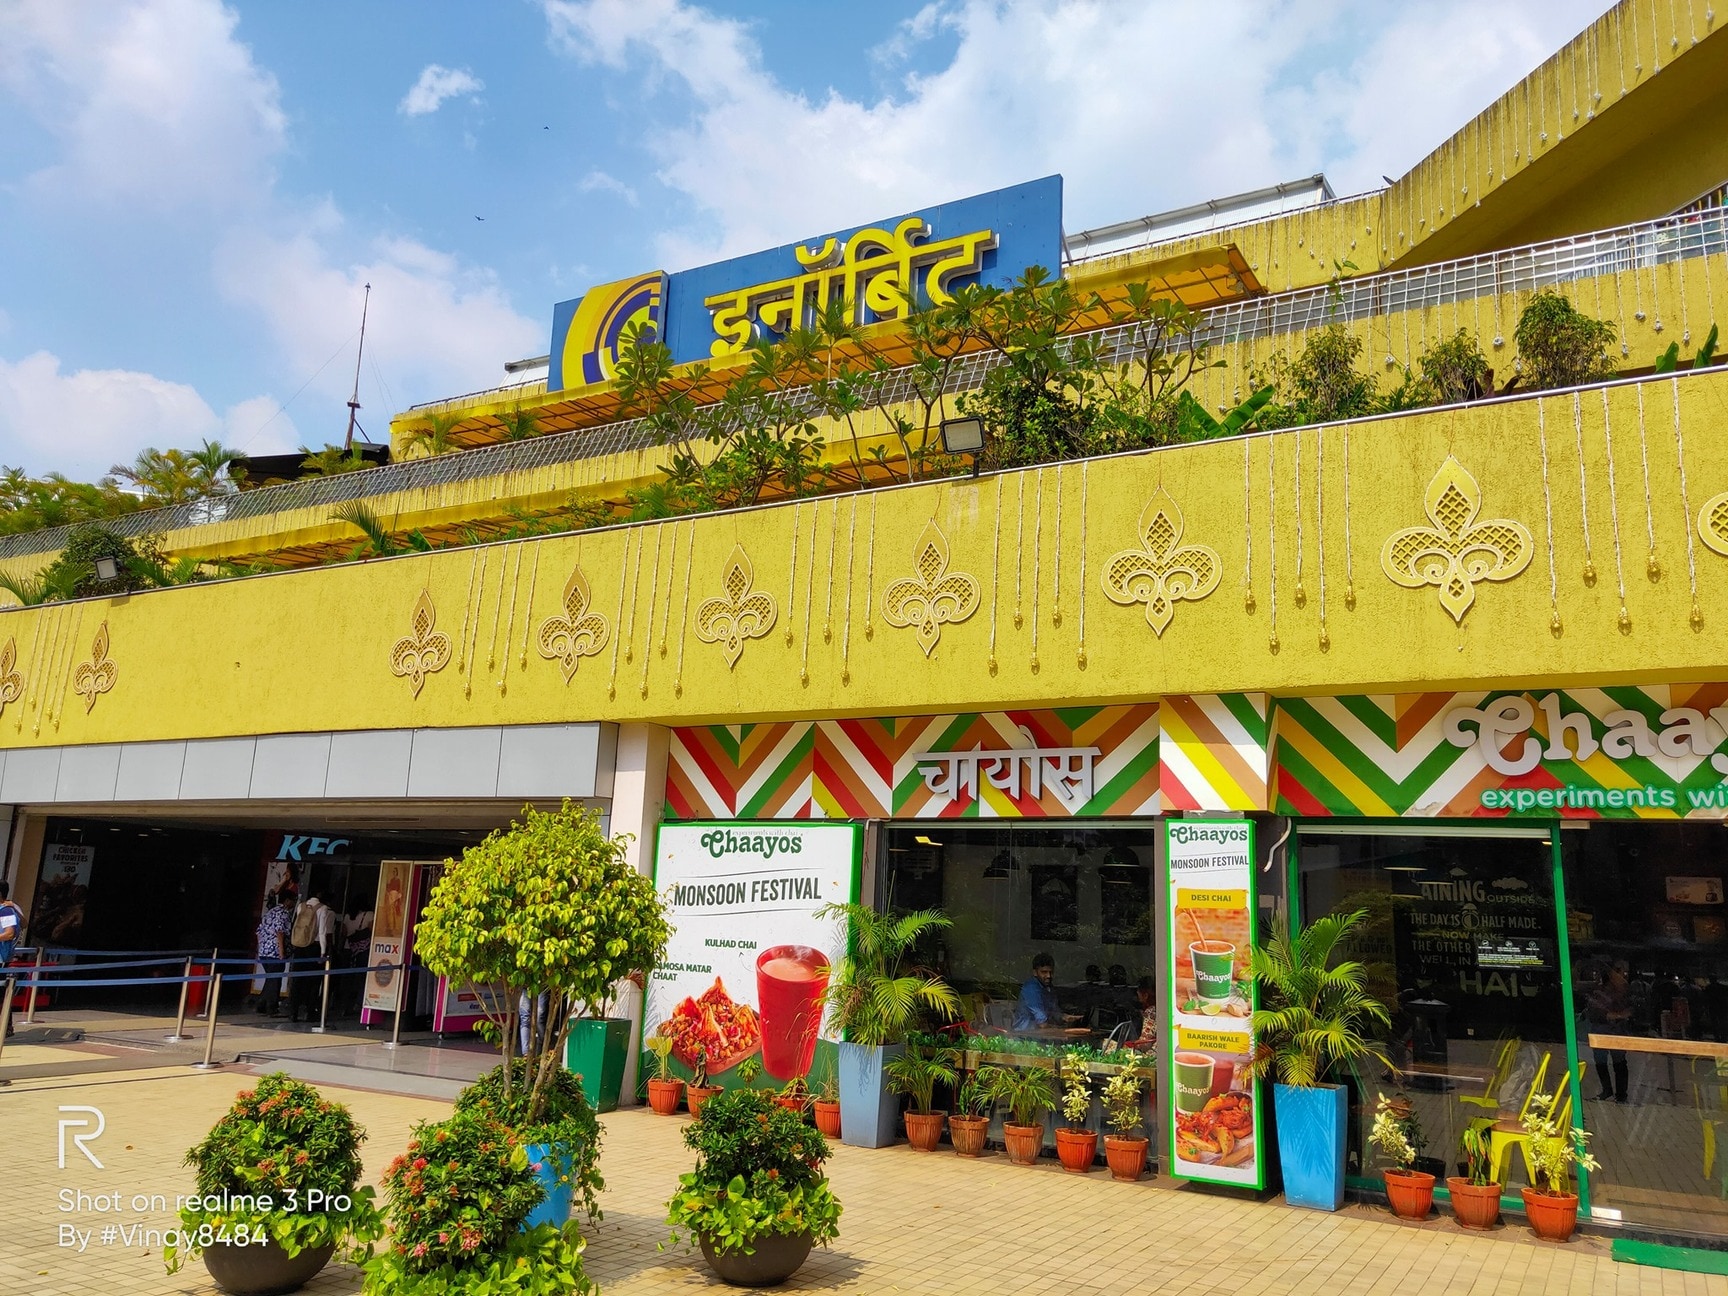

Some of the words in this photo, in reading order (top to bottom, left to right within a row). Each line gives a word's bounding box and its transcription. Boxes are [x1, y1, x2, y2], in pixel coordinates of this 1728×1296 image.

[1481, 785, 1675, 811] experiments
[1688, 785, 1728, 808] wi
[1170, 826, 1247, 844] Chaayos
[276, 835, 349, 860] KFC
[701, 830, 802, 859] Chaayos
[1171, 858, 1209, 869] MONSOON
[1212, 856, 1249, 867] FESTIVAL
[674, 882, 746, 906] MONSOON
[751, 877, 821, 902] FESTIVAL
[1413, 879, 1485, 902] AINING
[1410, 913, 1430, 925] THE
[1430, 913, 1449, 926] DAY
[1481, 915, 1505, 928] HALF
[374, 943, 399, 955] max
[705, 939, 736, 948] KULHAD
[738, 941, 757, 949] CHAI
[1436, 941, 1471, 953] OTHER
[686, 964, 712, 973] MATAR
[653, 972, 678, 981] CHAAT
[1452, 970, 1518, 997] HAI
[1187, 1033, 1218, 1042] BAARISH
[1219, 1034, 1240, 1043] WALE
[1199, 1041, 1228, 1050] PAKORE
